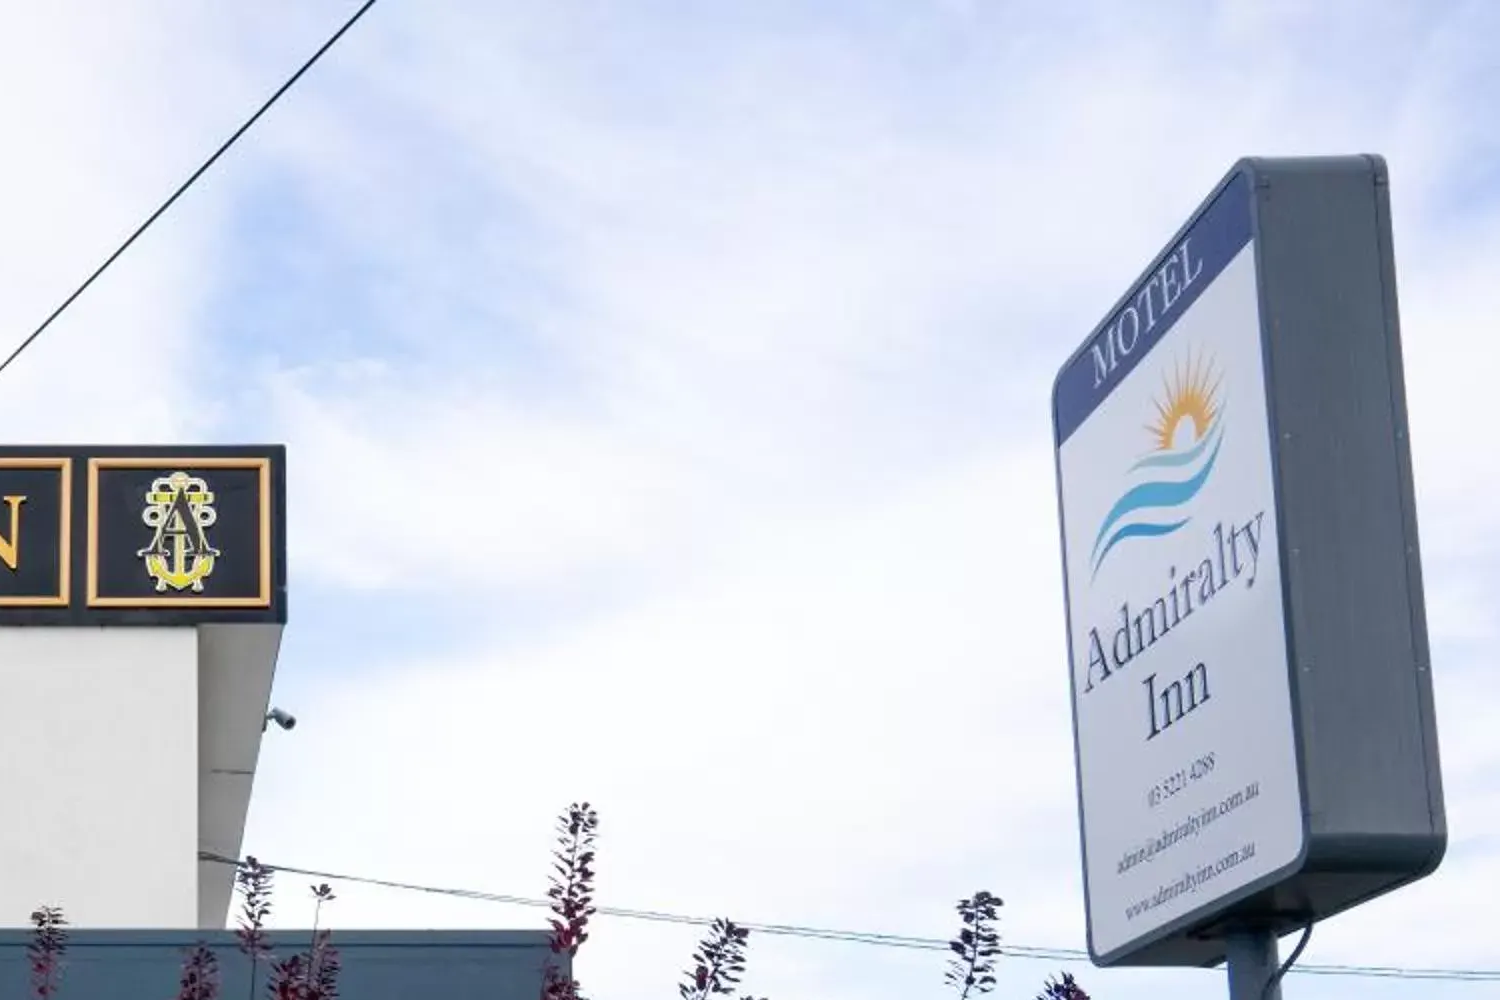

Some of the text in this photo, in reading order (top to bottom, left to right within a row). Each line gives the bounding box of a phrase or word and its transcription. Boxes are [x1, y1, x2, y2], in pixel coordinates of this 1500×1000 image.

[1090, 237, 1204, 389] MOTEL
[1083, 510, 1265, 694] Admiralty
[1141, 661, 1211, 741] Inn
